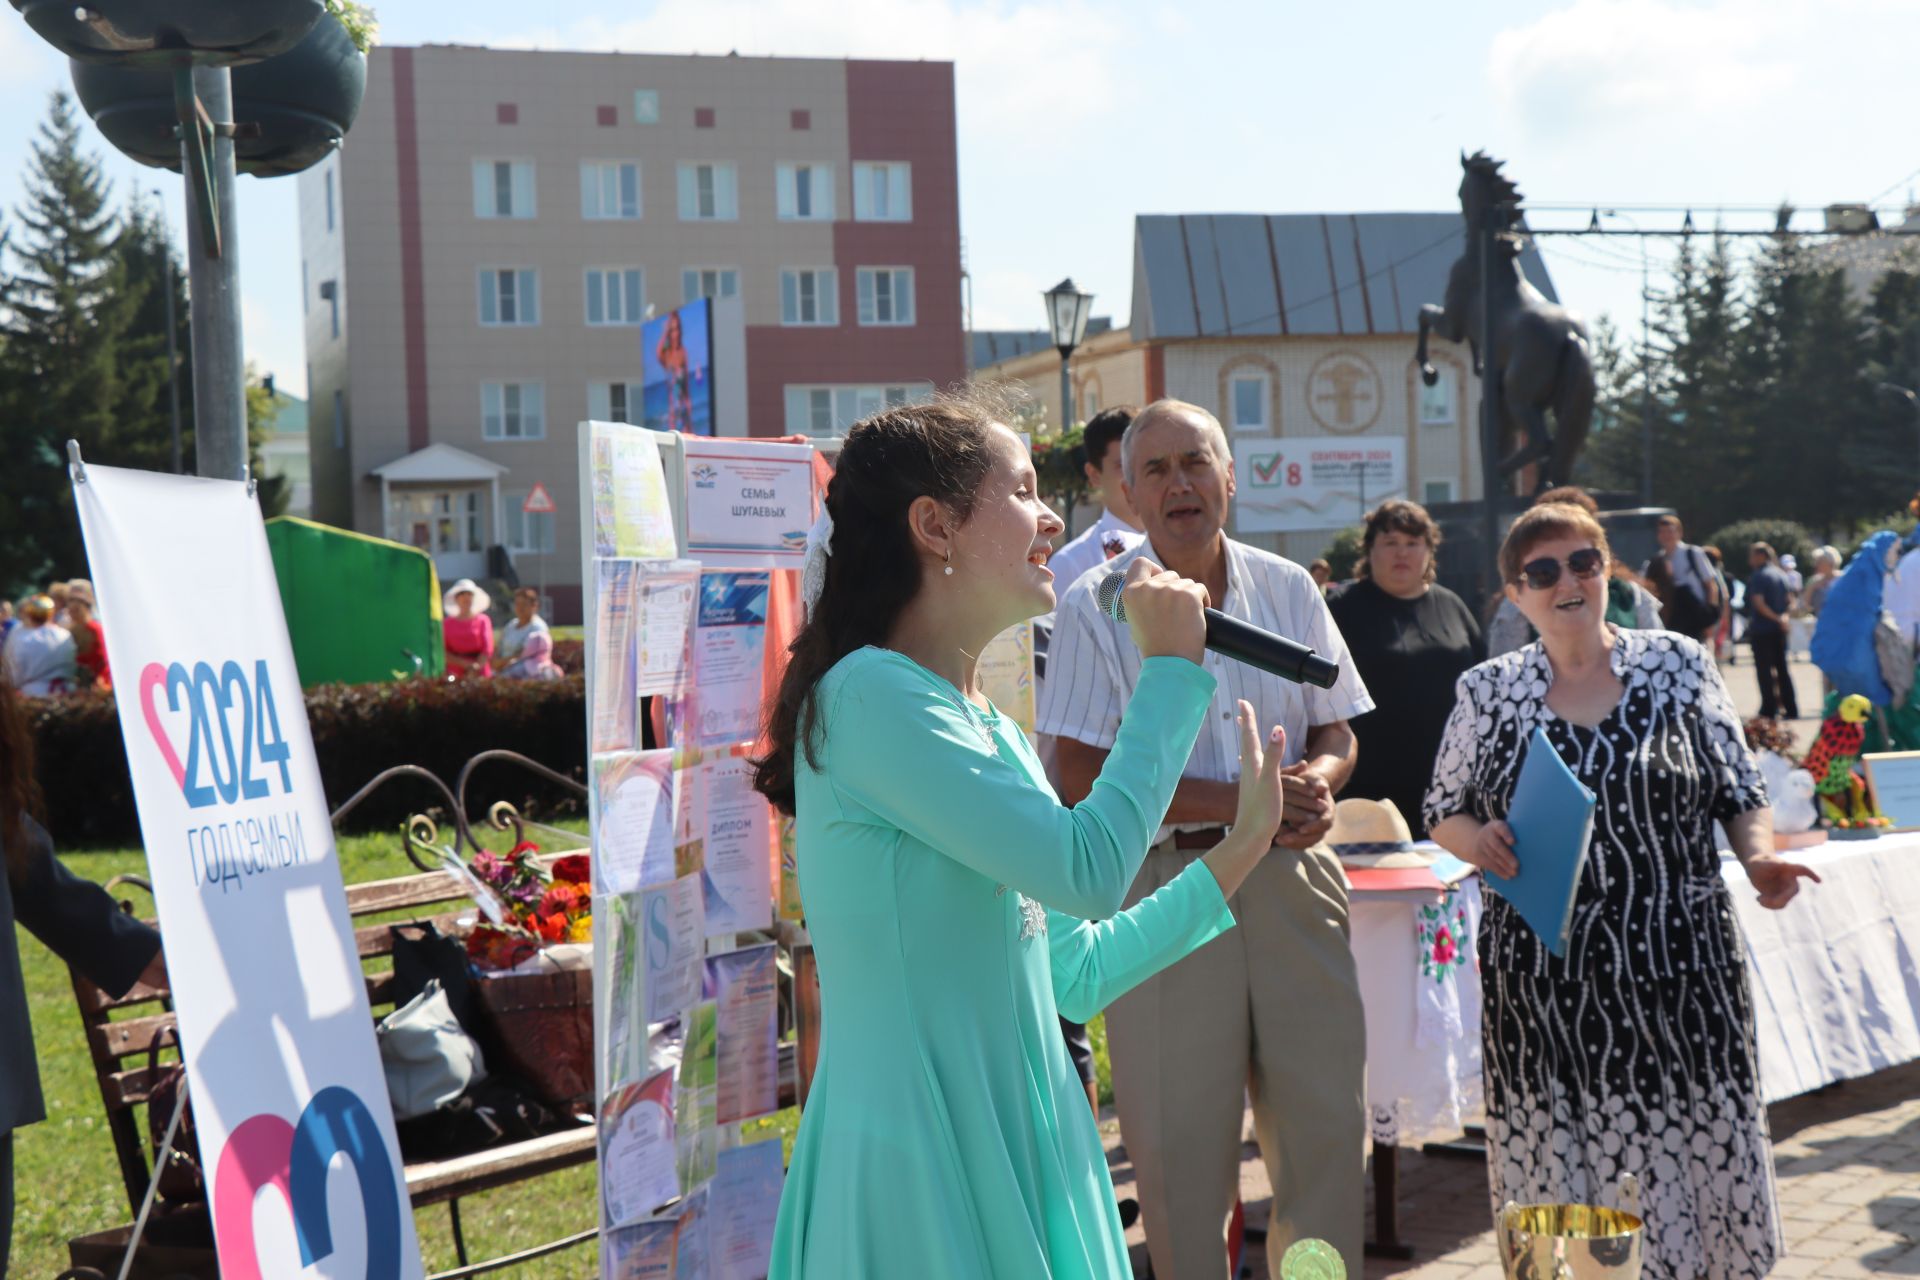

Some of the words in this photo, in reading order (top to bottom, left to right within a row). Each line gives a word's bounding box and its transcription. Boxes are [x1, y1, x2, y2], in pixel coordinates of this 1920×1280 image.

[1285, 462, 1302, 486] 8
[741, 488, 775, 499] СЕМЬЯ
[732, 506, 786, 518] ШУГАЕВЫХ
[166, 659, 293, 808] 2024
[711, 819, 752, 835] ДИПЛОМ
